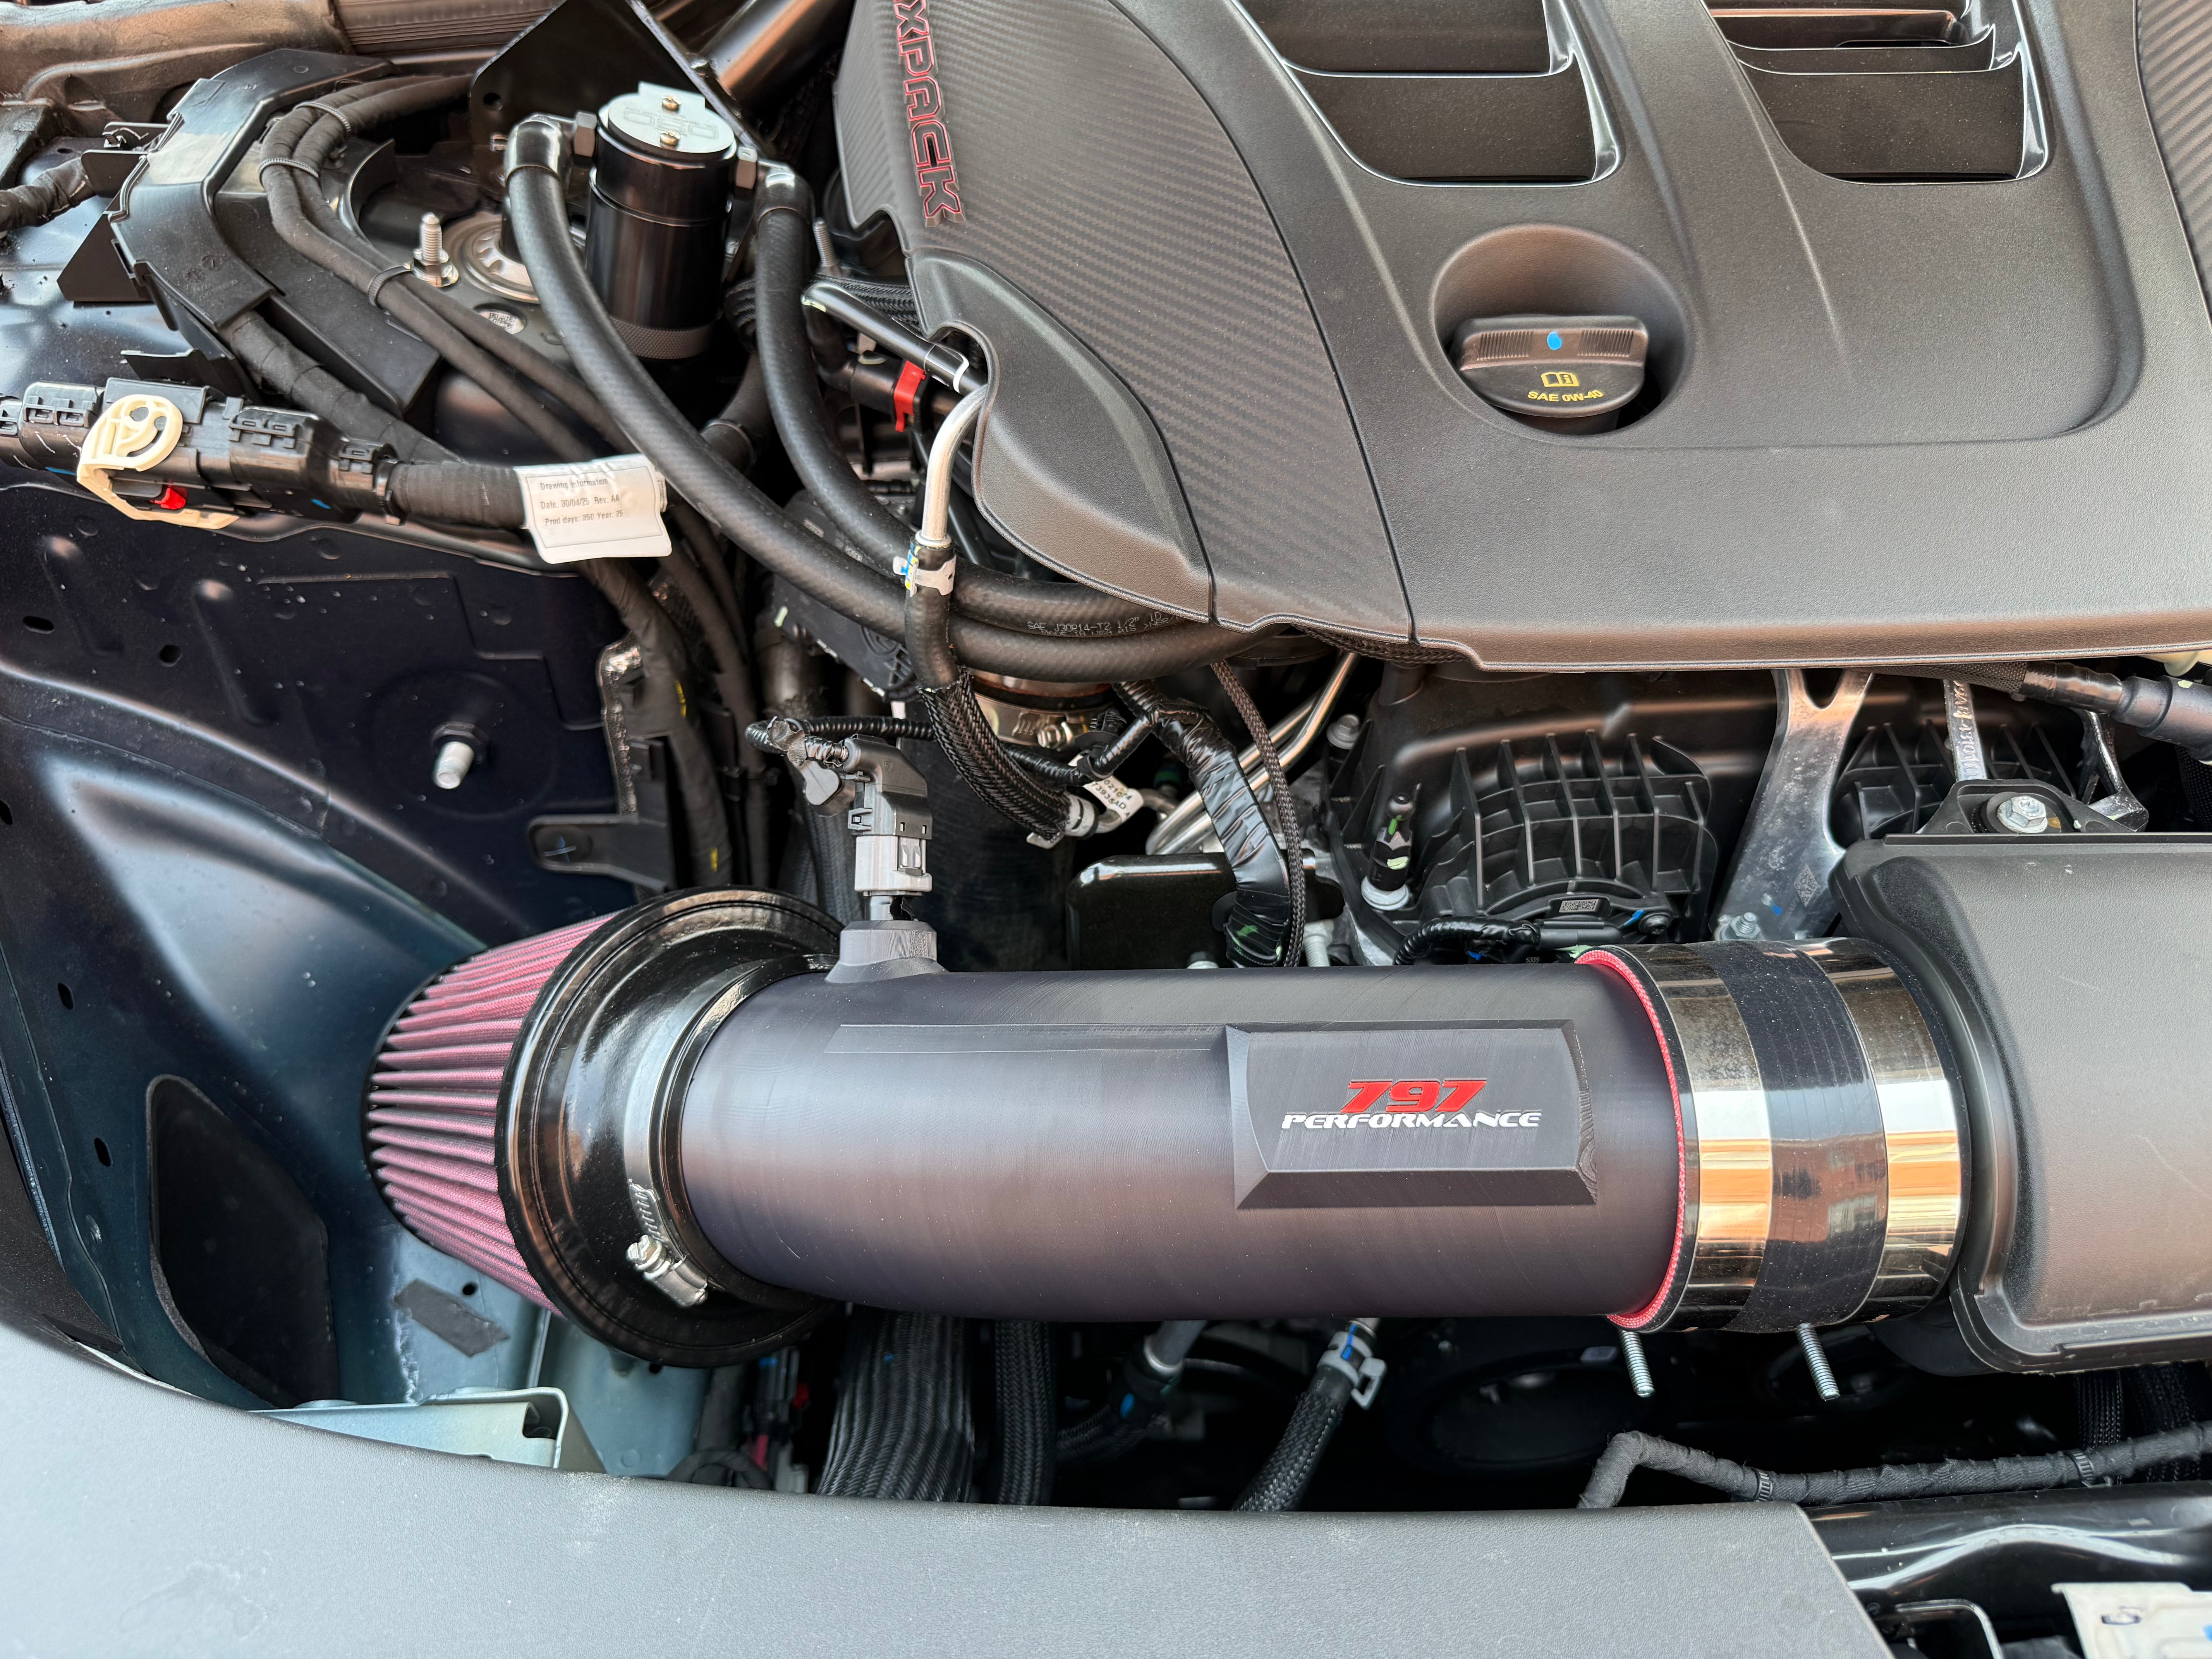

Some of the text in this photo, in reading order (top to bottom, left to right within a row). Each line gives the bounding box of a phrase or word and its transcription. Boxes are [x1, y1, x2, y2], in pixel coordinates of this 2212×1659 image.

[894, 0, 964, 222] XPACK
[1527, 390, 1604, 402] SAE 0W-40
[540, 481, 568, 490] Drawing
[541, 500, 559, 509] Date:
[561, 497, 589, 507] 30/04/25
[611, 495, 620, 503] AA
[545, 516, 560, 526] Prod
[563, 515, 580, 524] days:
[597, 511, 614, 520] Year:
[1027, 622, 1046, 631] SAE
[1150, 611, 1162, 622] ID
[1340, 1079, 1487, 1113] 797
[1281, 1110, 1542, 1129] PERFORMANCE
